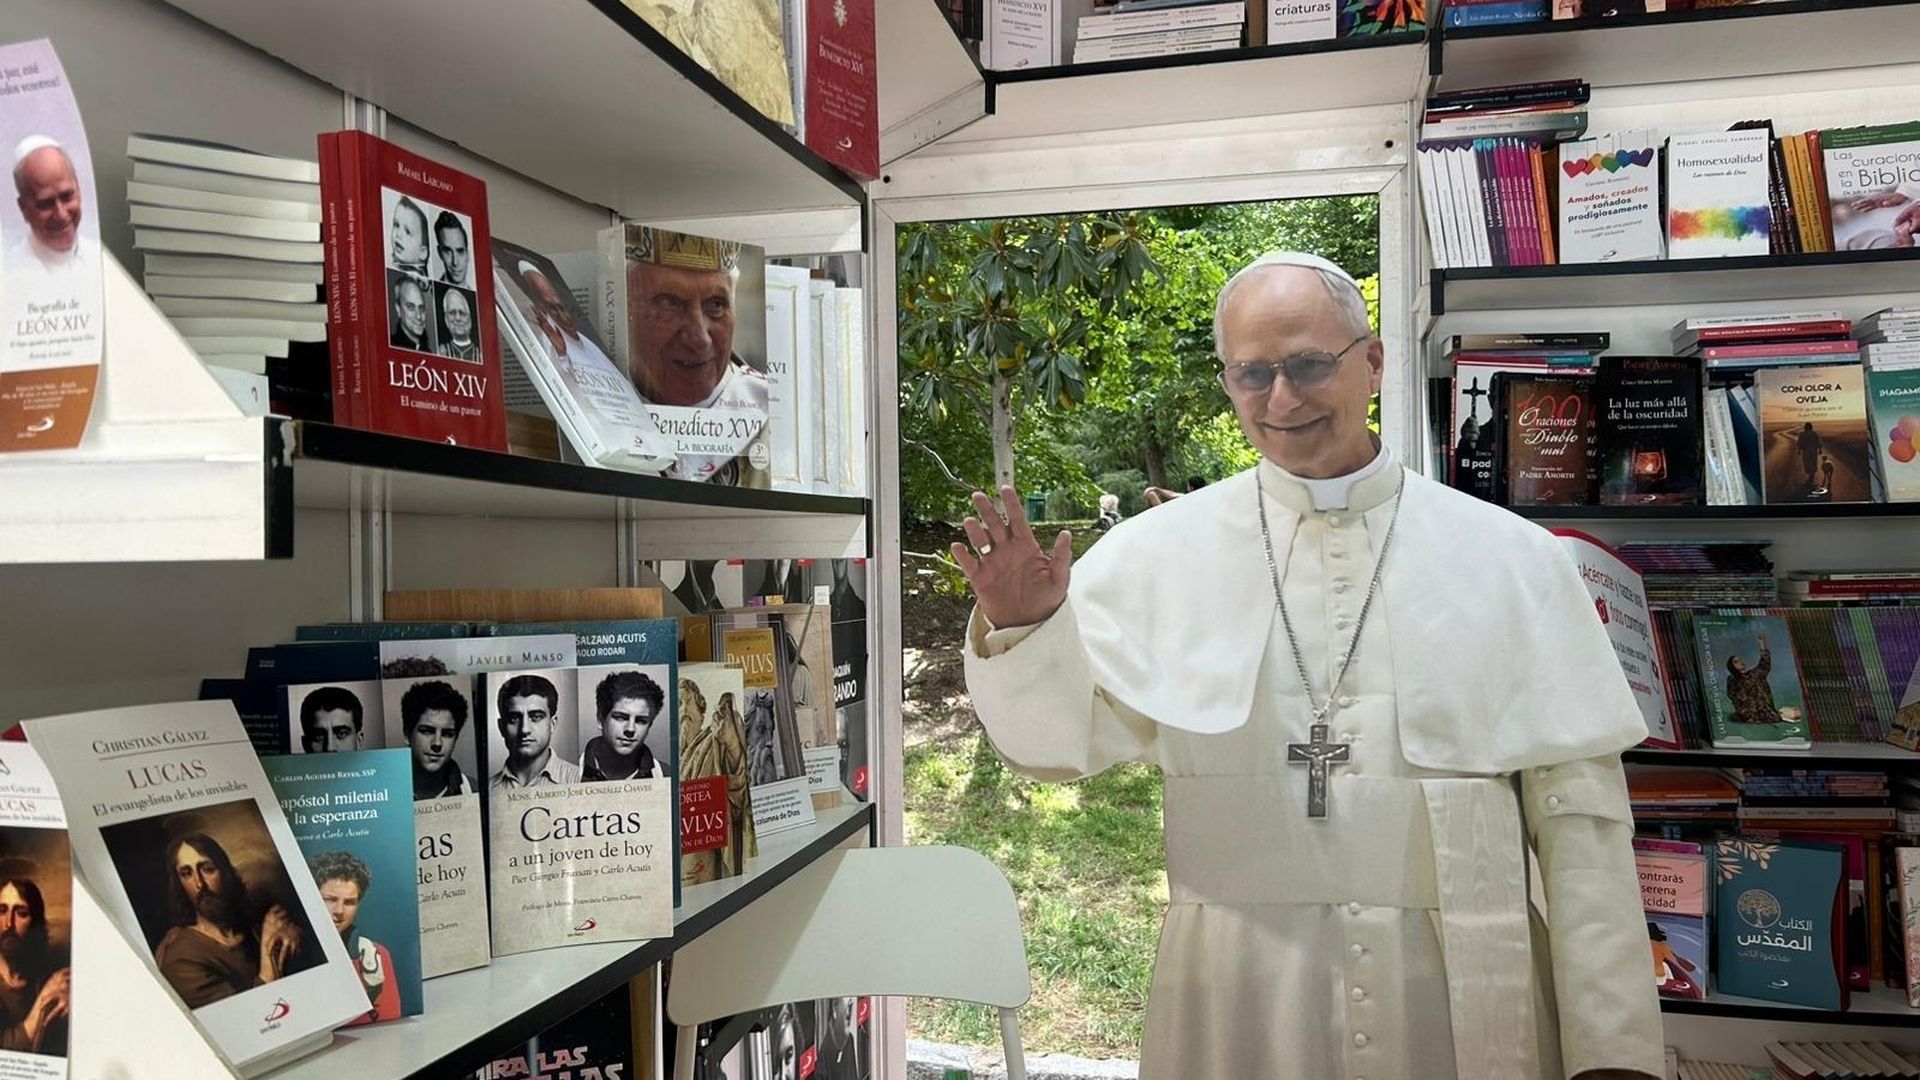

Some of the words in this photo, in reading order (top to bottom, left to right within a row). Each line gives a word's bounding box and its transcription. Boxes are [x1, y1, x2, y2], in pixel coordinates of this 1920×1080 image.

[1274, 3, 1331, 16] criaturas
[1677, 153, 1763, 167] Homosexualidad
[1833, 152, 1853, 161] Las
[1841, 179, 1852, 188] la
[1567, 193, 1609, 204] Amados,
[1611, 185, 1649, 198] creados
[1592, 197, 1632, 210] soñados
[1568, 203, 1649, 223] prodigiosamente
[16, 315, 59, 337] LEÓN
[62, 314, 91, 333] XIV
[388, 359, 448, 394] LEÓN
[453, 372, 487, 400] XIV
[1781, 385, 1803, 394] CON
[1804, 383, 1832, 393] OLOR
[1834, 383, 1843, 391] A
[401, 395, 410, 408] El
[410, 400, 439, 411] camino
[439, 401, 449, 413] de
[1609, 398, 1622, 409] La
[1625, 397, 1640, 408] luz
[1643, 397, 1664, 408] más
[1667, 396, 1687, 407] allá
[1795, 395, 1828, 404] OVEJA
[1518, 406, 1577, 427] Oraciones
[1607, 409, 1620, 420] de
[1623, 409, 1633, 420] la
[1635, 407, 1688, 420] oscuridad
[650, 409, 723, 437] Benedicto
[727, 418, 762, 438] XVI
[1524, 428, 1578, 445] Diablo
[677, 440, 690, 451] LA
[692, 442, 735, 454] BIOGRAFÍA
[1540, 444, 1567, 456] mal
[1461, 458, 1470, 468] El
[1471, 458, 1492, 470] pad
[1477, 470, 1490, 478] co
[1519, 470, 1543, 479] PADRE
[1544, 470, 1575, 479] AMORTH
[575, 634, 615, 646] SALZANO
[616, 632, 647, 644] ACUTIS
[466, 654, 513, 666] JAVIER
[522, 652, 564, 664] MANSO
[833, 679, 857, 702] RANDO
[92, 735, 161, 755] CHRISTIAN
[162, 730, 210, 745] GÁLVEZ
[126, 758, 208, 790] LUCAS
[362, 768, 377, 776] SSP
[808, 776, 823, 784] Dios
[623, 784, 652, 793] CHAVES
[92, 803, 108, 817] El
[110, 794, 173, 811] evangelista
[174, 790, 188, 801] de
[188, 787, 204, 799] los
[205, 780, 249, 796] invisibles
[280, 792, 330, 812] apóstol
[334, 788, 390, 805] milenial
[0, 801, 37, 813] UCAS
[294, 811, 307, 825] la
[311, 808, 379, 826] esperanza
[756, 814, 779, 826] columna
[787, 808, 801, 818] Dios
[519, 806, 641, 843] Cartas
[705, 833, 724, 845] DIOS
[509, 857, 519, 868] a
[523, 852, 545, 866] un
[548, 848, 594, 866] joven
[599, 841, 619, 858] de
[624, 840, 653, 859] hoy
[437, 864, 466, 881] hoy
[511, 875, 528, 885] Pier
[600, 865, 624, 875] Carlo
[625, 863, 652, 873] Acutis
[1637, 872, 1684, 885] ontrarás
[1640, 885, 1677, 896] serena
[1643, 897, 1676, 909] icidad
[1778, 918, 1813, 932] الكتاب
[1737, 929, 1812, 952] المقدّس
[536, 1045, 589, 1072] LAS
